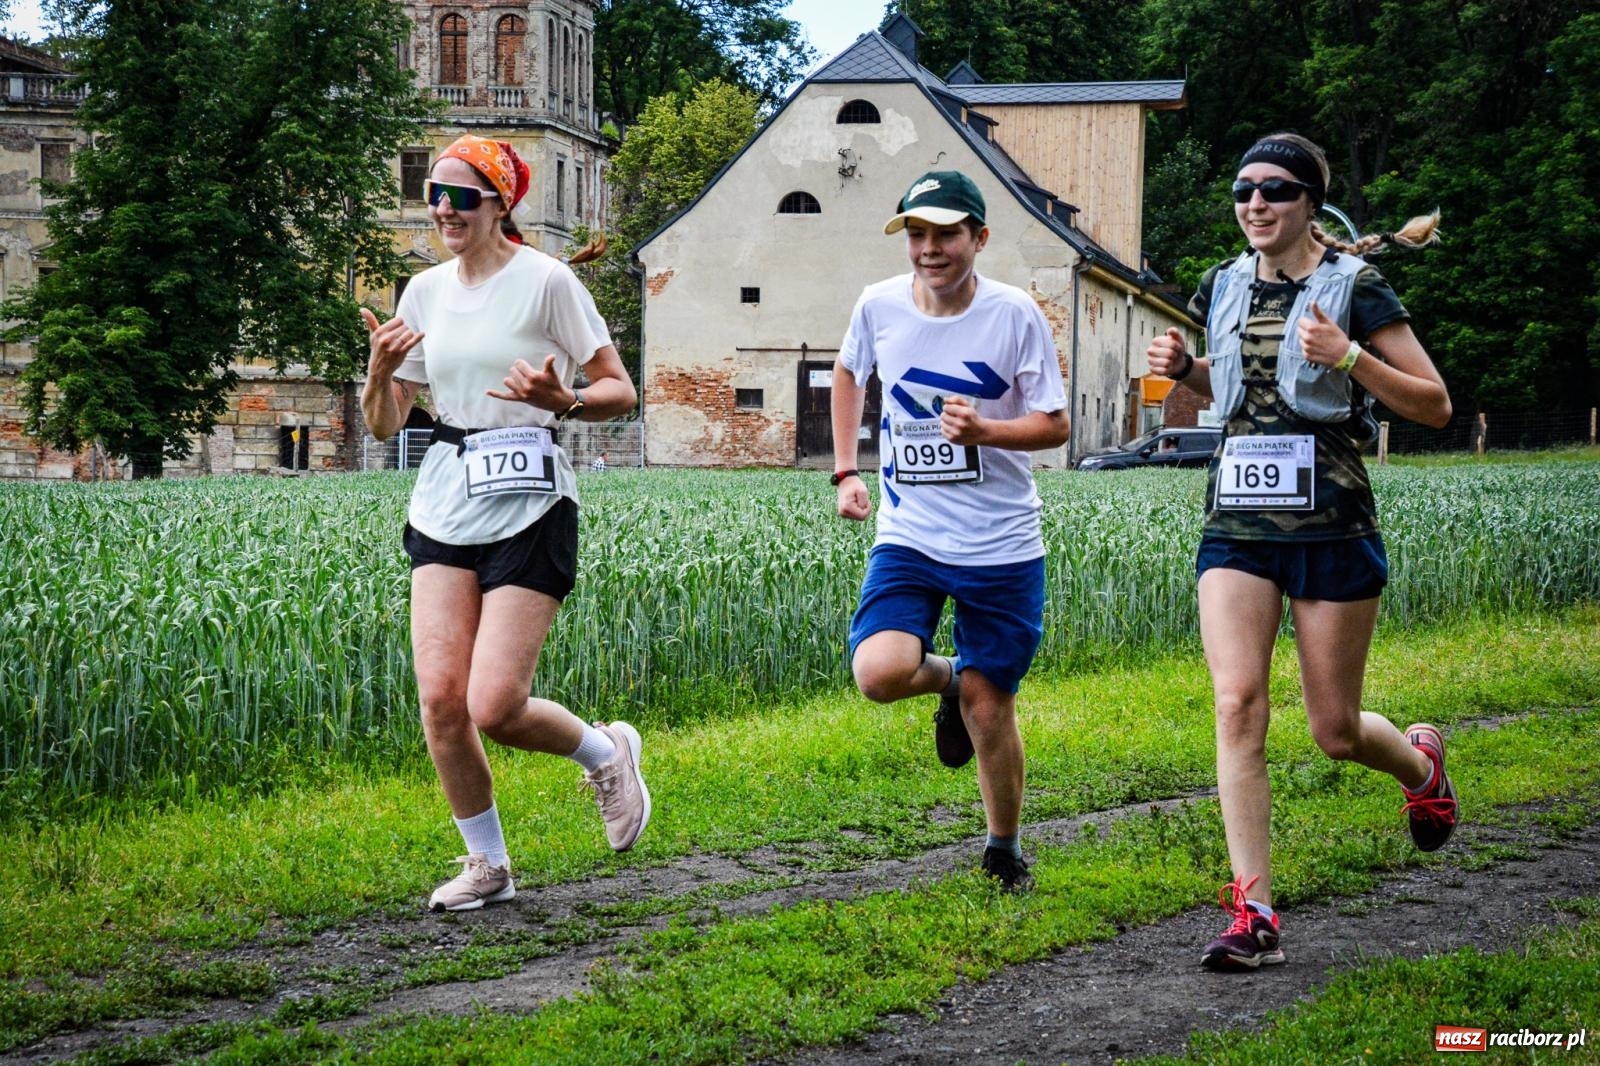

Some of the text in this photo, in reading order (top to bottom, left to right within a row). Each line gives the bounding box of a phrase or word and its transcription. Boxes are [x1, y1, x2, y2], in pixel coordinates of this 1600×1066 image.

[904, 443, 954, 466] 099
[1264, 442, 1294, 450] PIĄTKĘ
[483, 450, 528, 476] 170
[1234, 463, 1280, 488] 169
